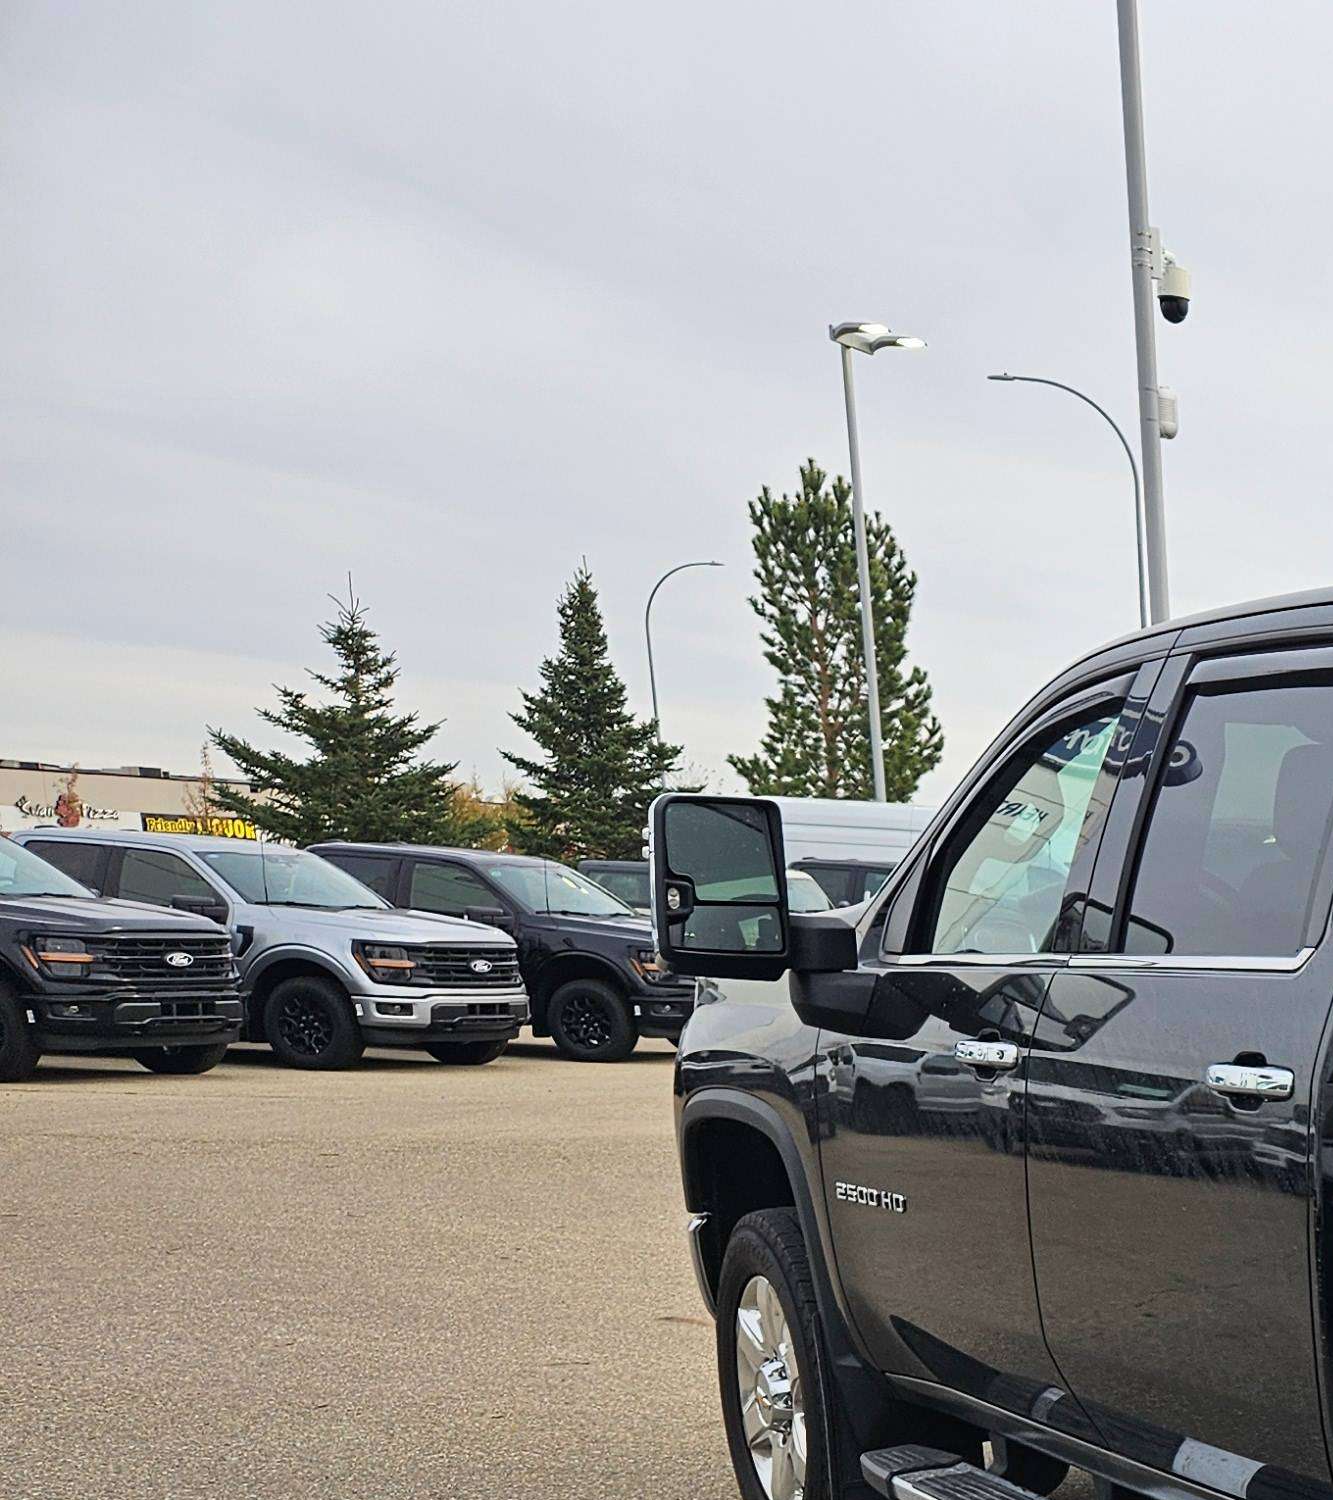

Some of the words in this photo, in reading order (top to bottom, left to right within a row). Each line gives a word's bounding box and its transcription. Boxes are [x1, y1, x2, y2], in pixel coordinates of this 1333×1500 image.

[145, 817, 195, 833] Friendly
[835, 1181, 879, 1207] 2500
[880, 1190, 907, 1213] HD
